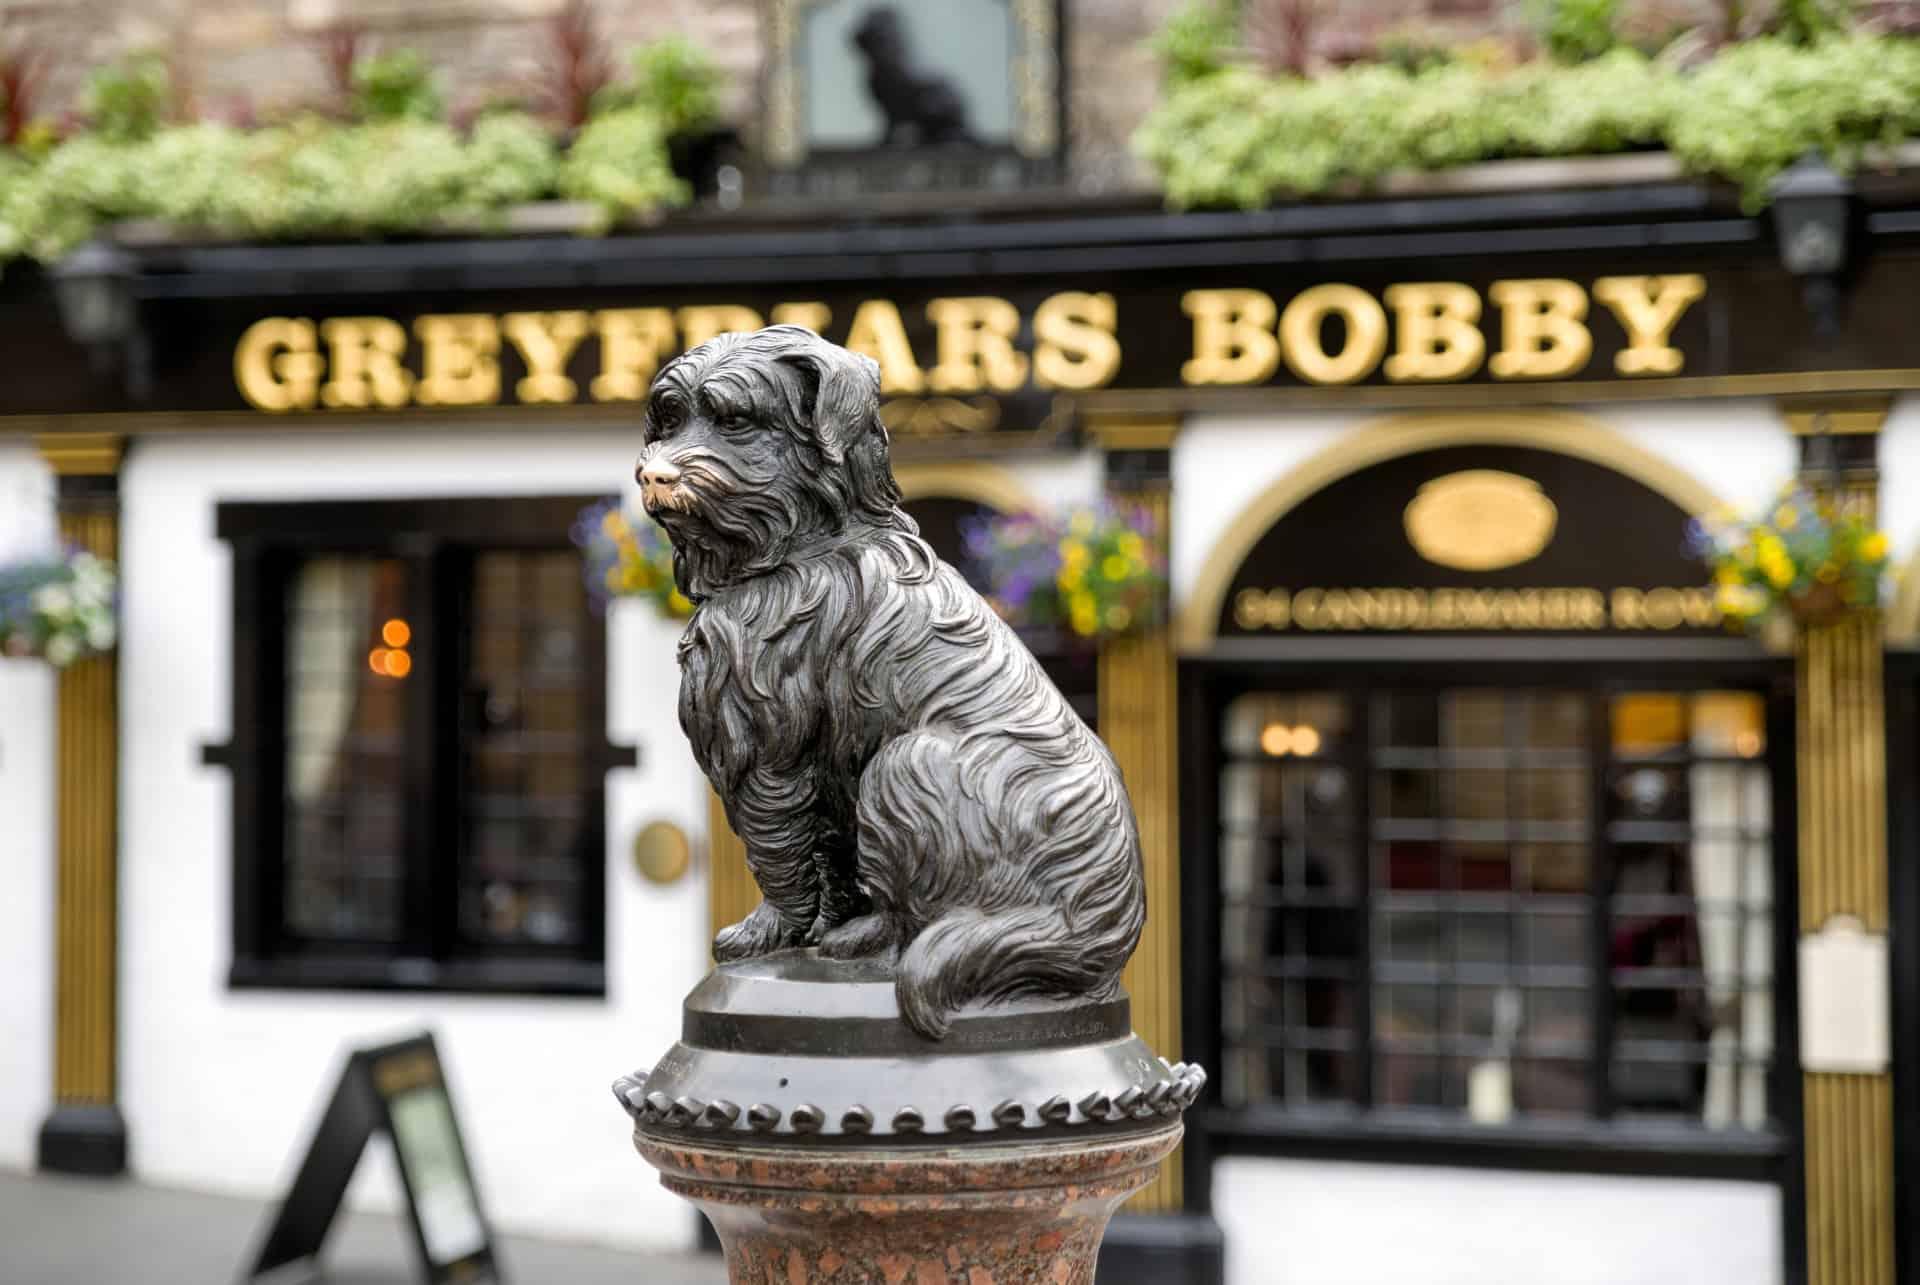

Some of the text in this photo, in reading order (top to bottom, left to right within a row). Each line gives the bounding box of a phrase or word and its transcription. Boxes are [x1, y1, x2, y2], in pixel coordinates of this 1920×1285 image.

[233, 273, 1706, 412] GREYFARS BOBBY
[1292, 587, 1605, 630] CANDLEMAKER
